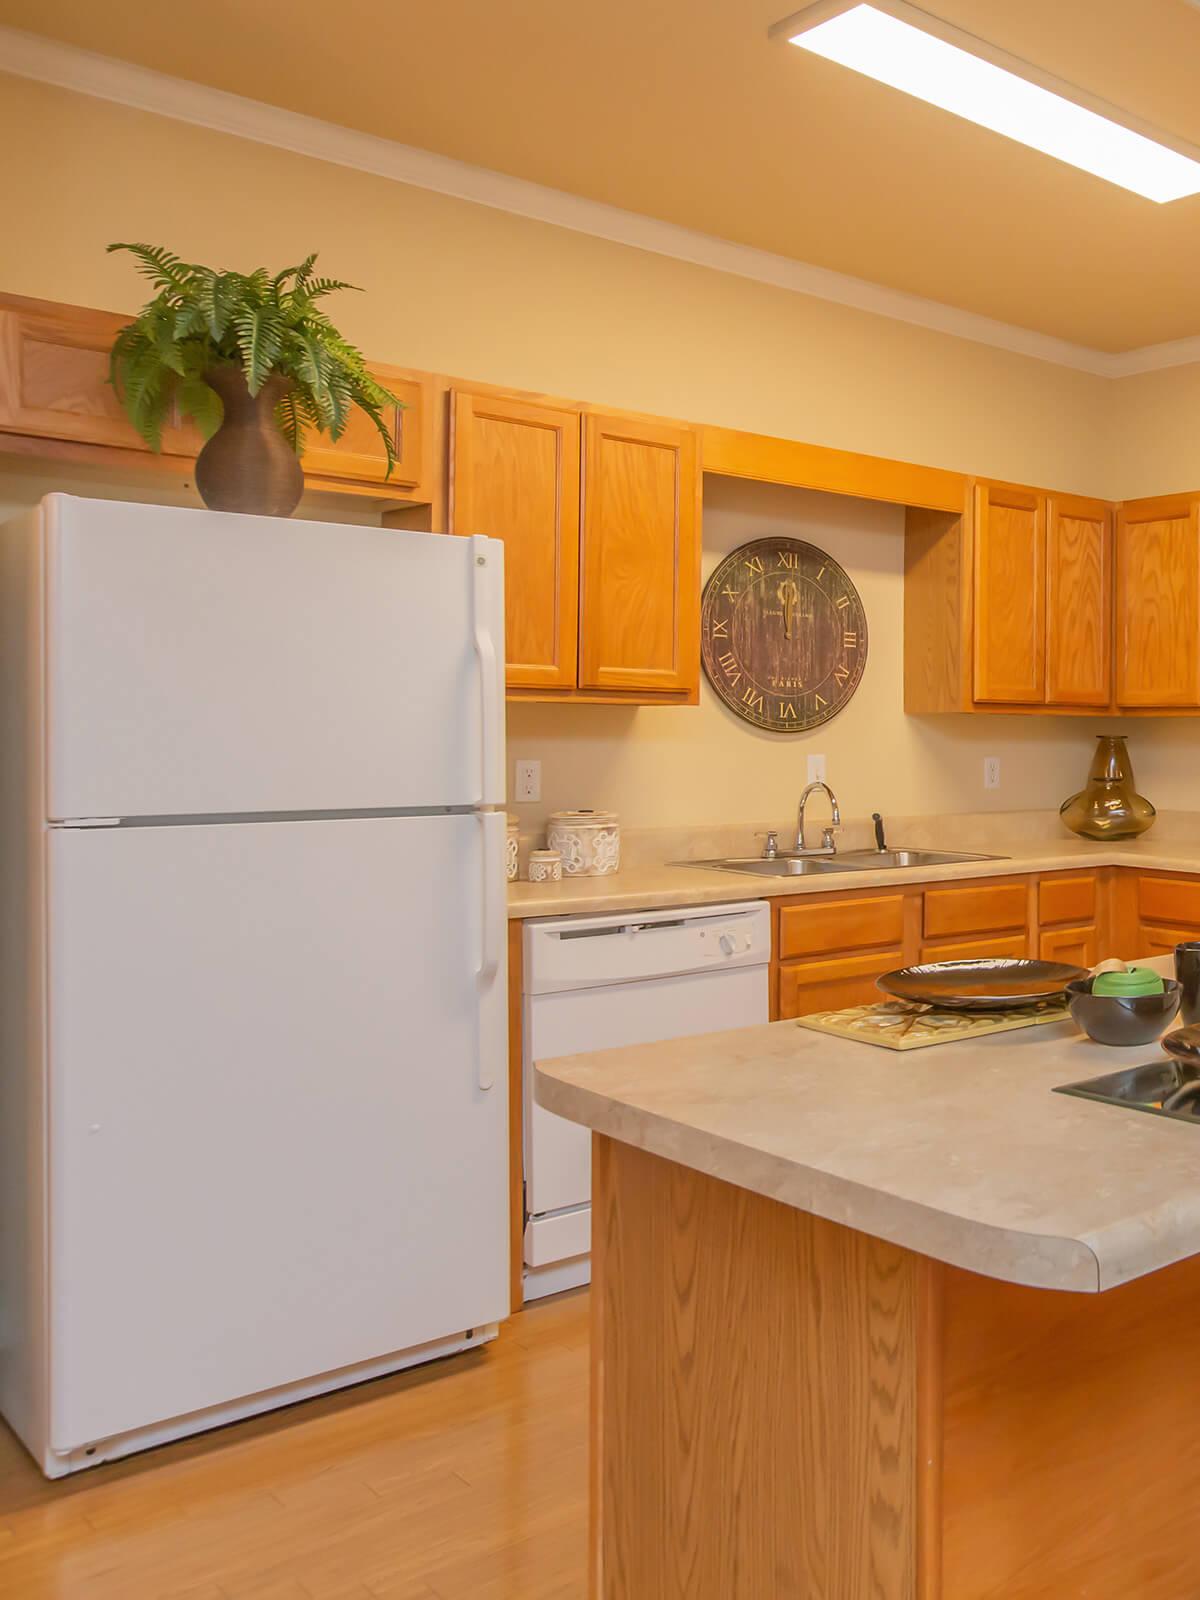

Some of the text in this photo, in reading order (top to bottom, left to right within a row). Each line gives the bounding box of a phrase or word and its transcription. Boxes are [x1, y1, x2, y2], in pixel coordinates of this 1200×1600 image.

[745, 556, 764, 577] XI
[777, 551, 798, 569] XII
[815, 567, 826, 581] I
[721, 584, 739, 603] X
[835, 596, 849, 609] II
[713, 619, 729, 638] IX
[844, 632, 857, 649] III
[719, 652, 742, 688] VIII
[833, 664, 850, 689] IV
[742, 687, 765, 713] VII
[813, 694, 828, 711] V
[779, 703, 797, 719] VI
